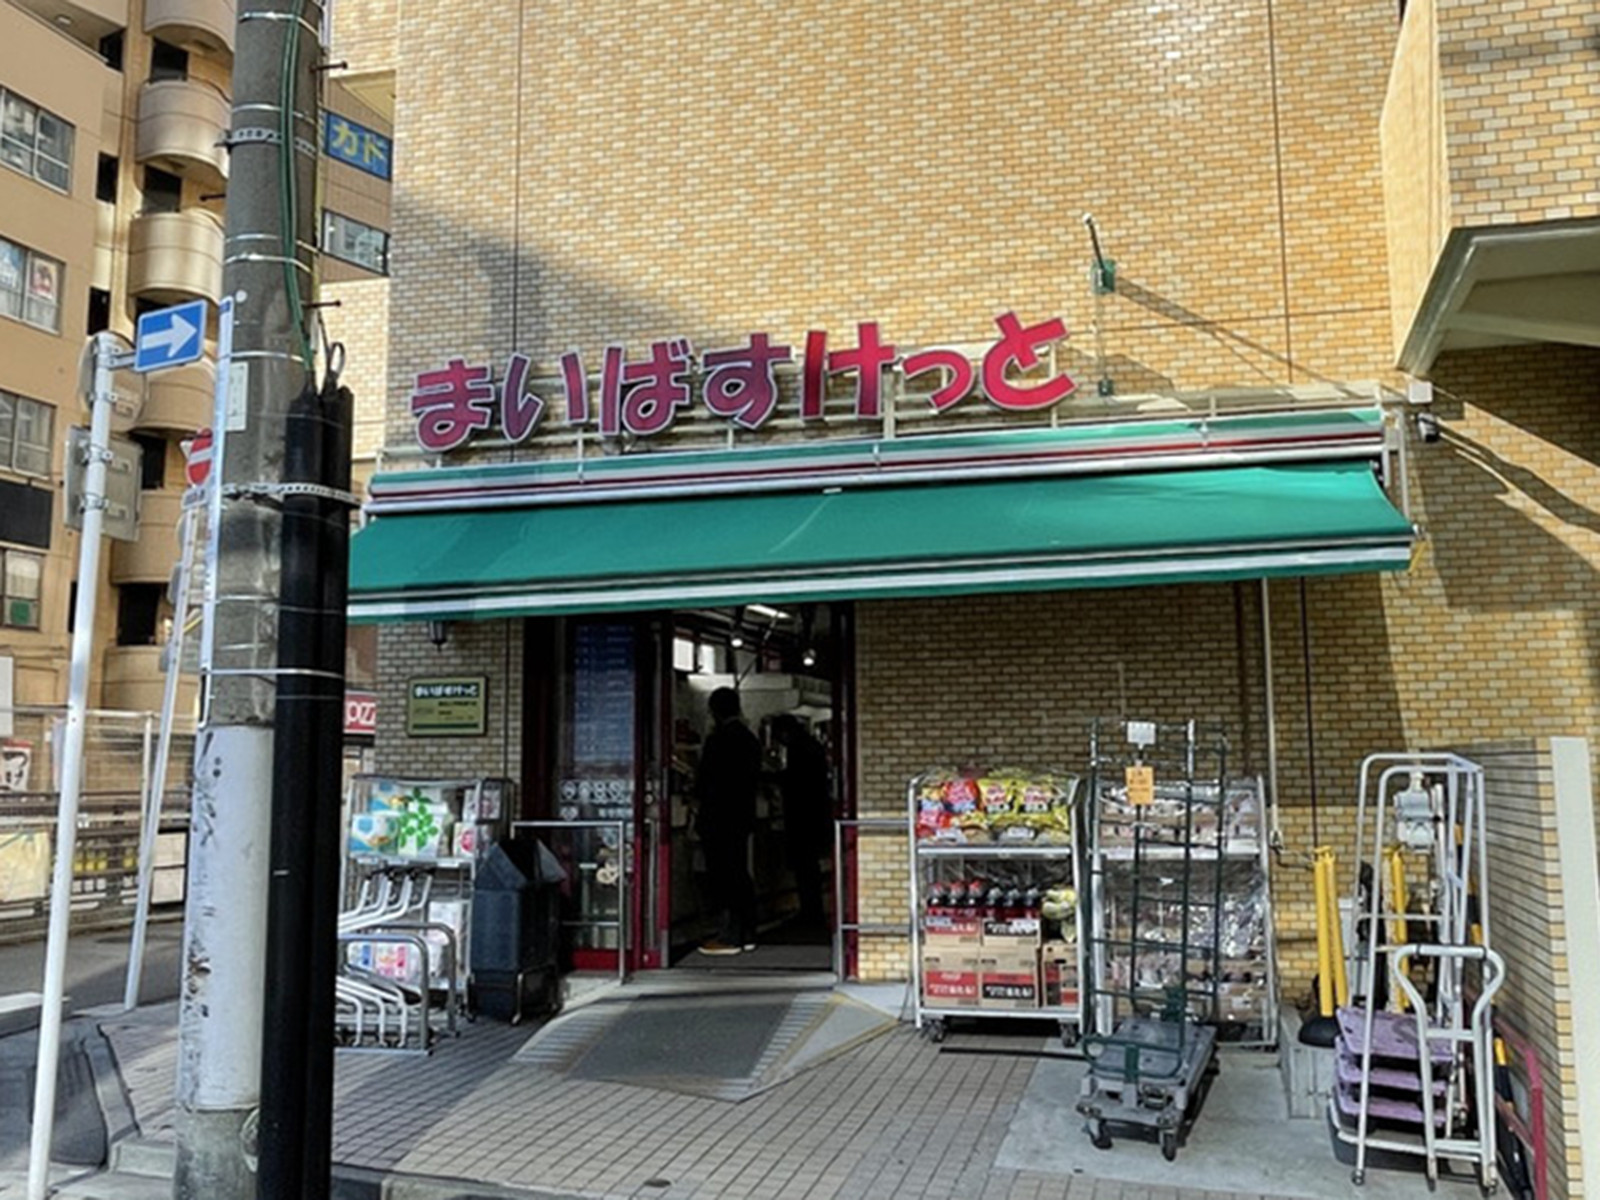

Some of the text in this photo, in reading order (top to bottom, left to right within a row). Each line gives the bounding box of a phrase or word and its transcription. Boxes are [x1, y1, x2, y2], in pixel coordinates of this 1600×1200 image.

[411, 311, 1076, 451] まいばすけっと
